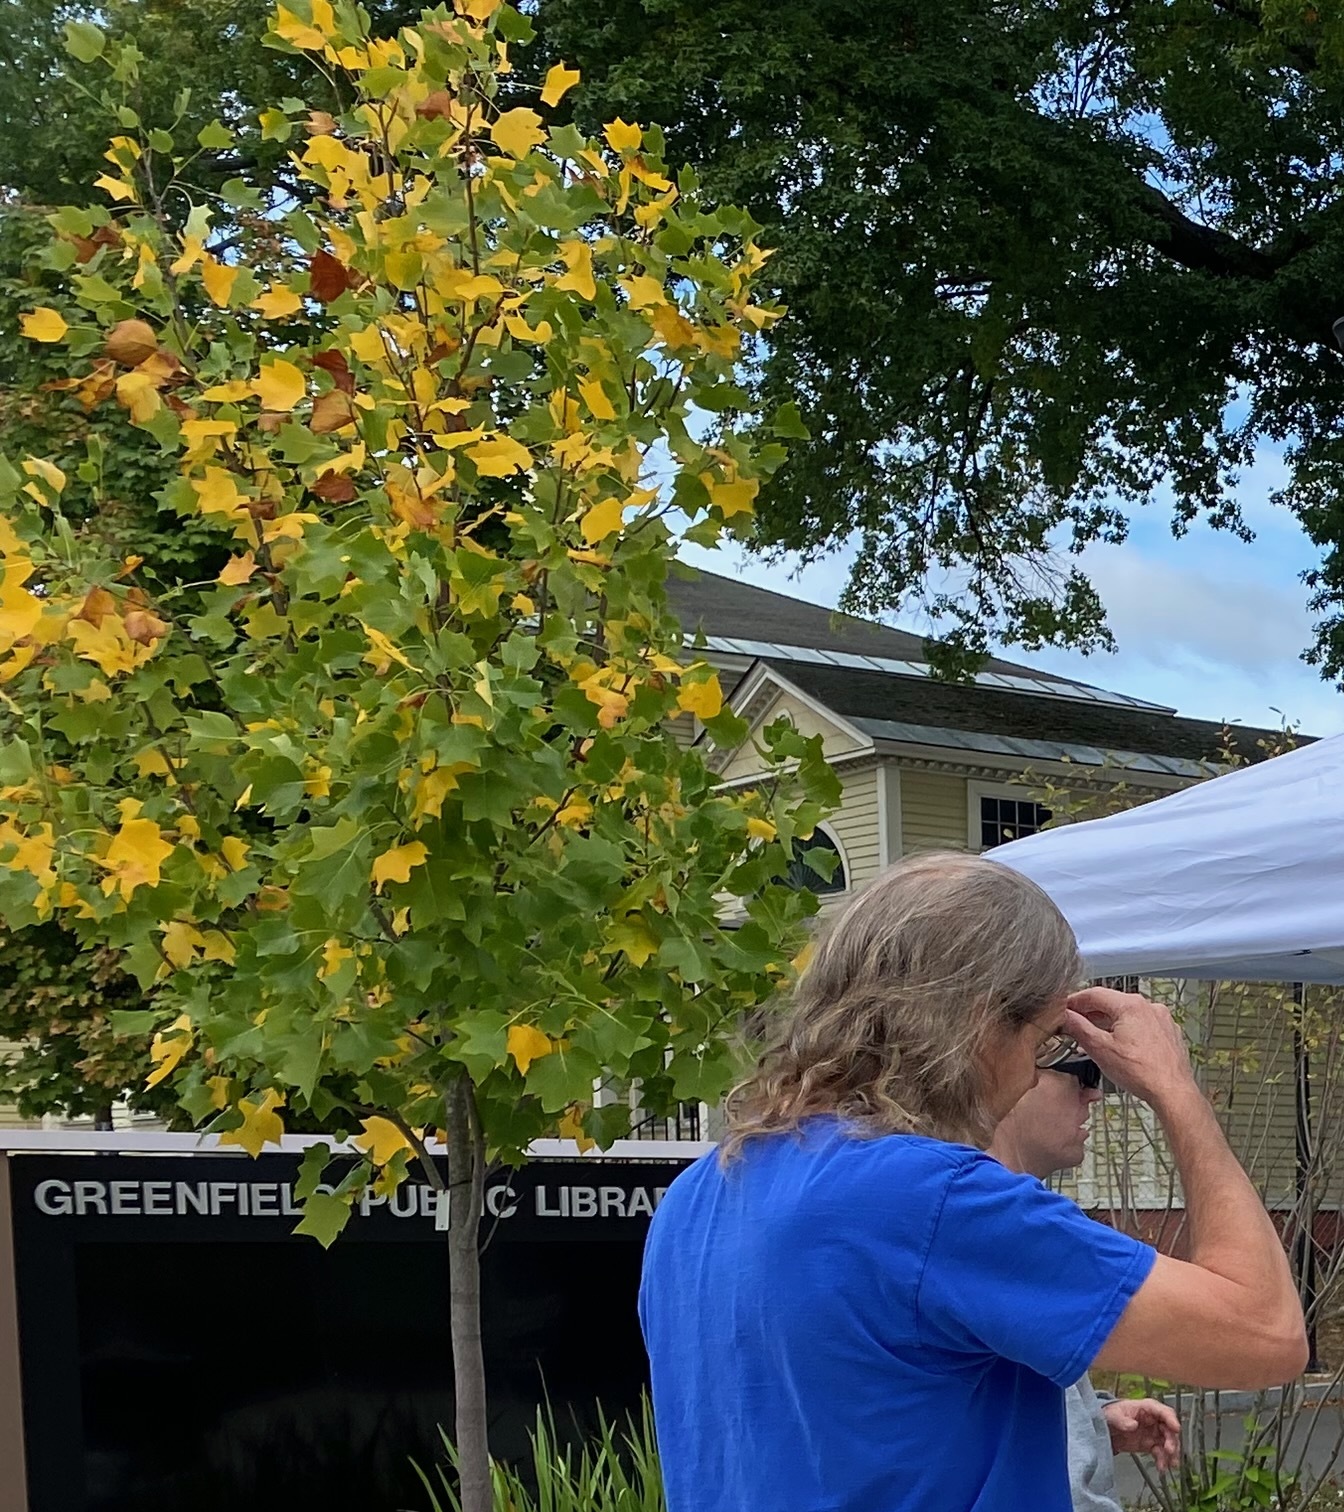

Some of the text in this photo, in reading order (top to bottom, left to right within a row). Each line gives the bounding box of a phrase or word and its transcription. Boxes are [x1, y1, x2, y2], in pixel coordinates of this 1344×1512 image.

[33, 1179, 668, 1217] GREENFIEL PUBC LIBRA
